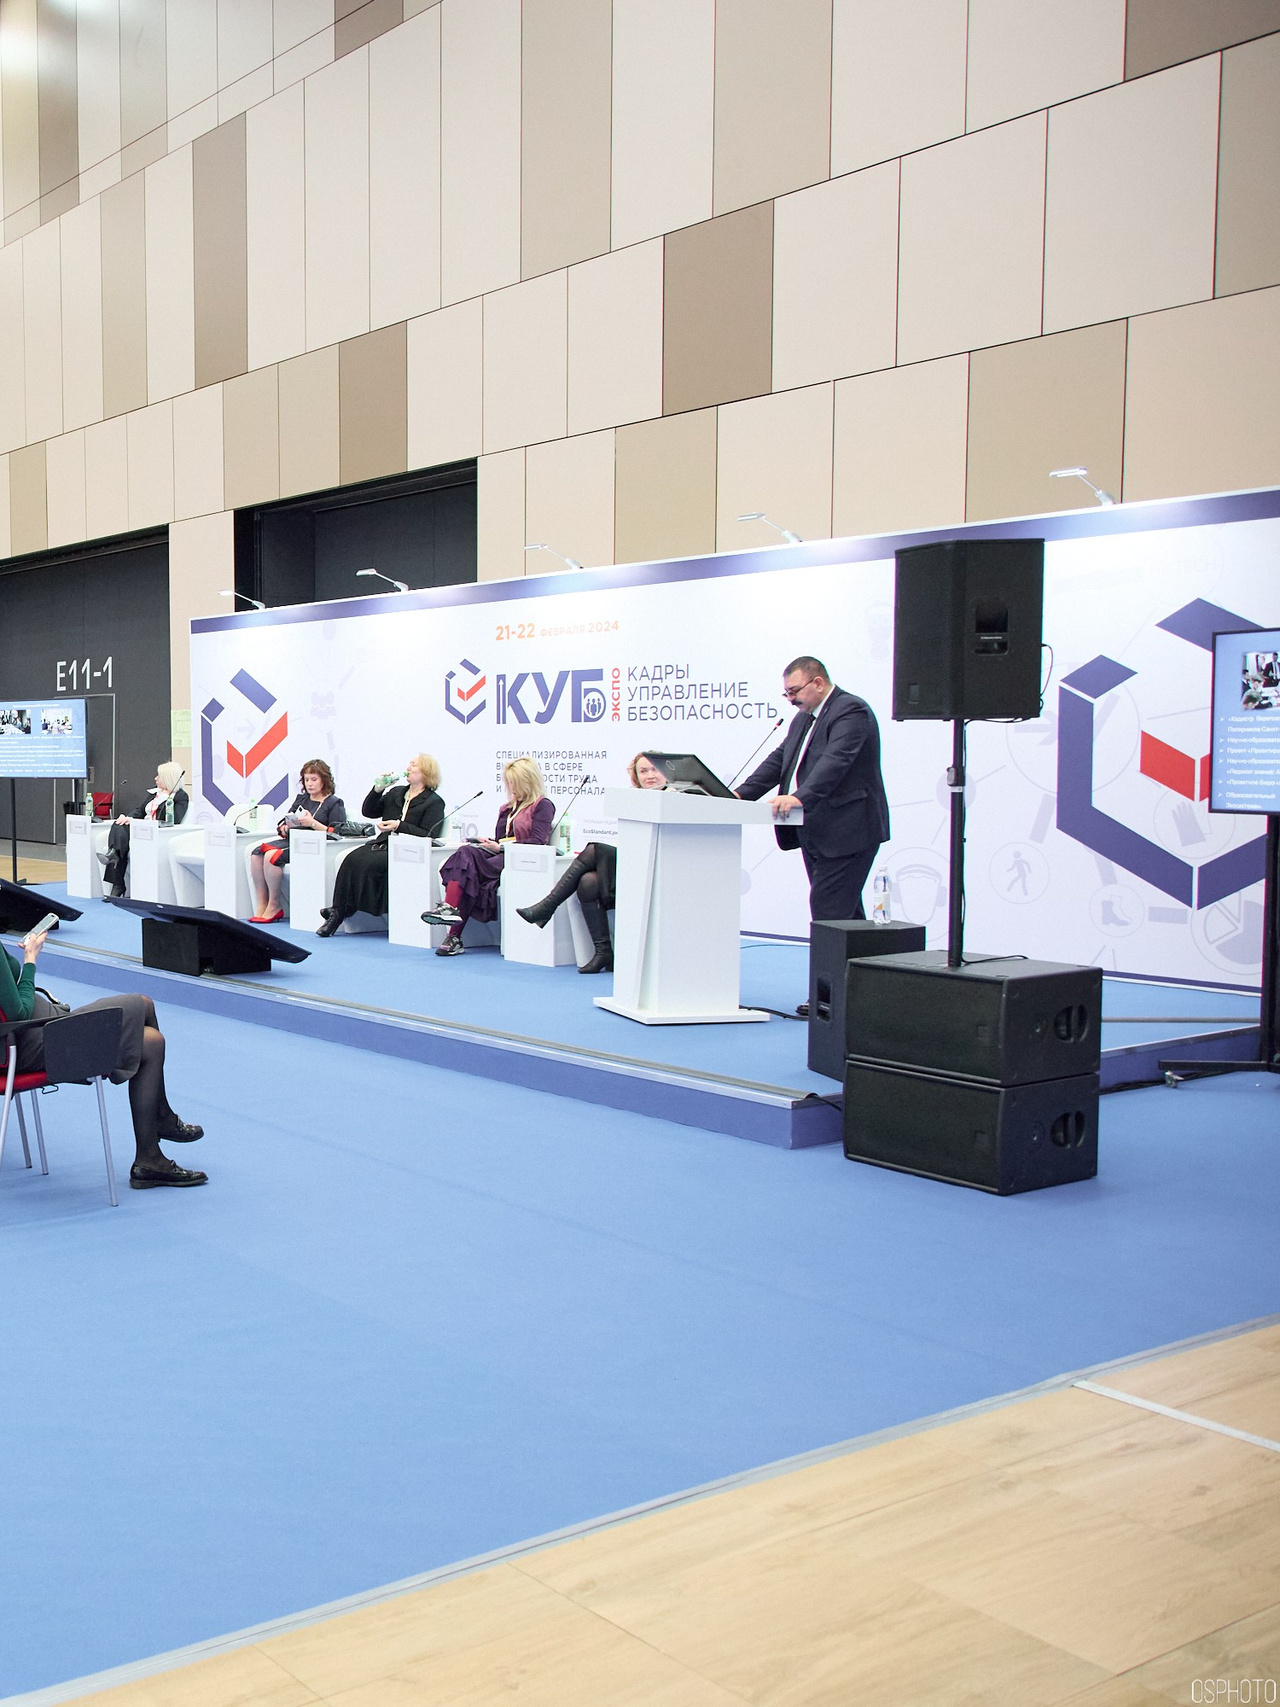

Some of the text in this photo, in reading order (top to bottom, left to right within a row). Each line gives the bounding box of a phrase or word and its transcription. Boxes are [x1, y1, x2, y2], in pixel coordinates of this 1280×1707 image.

[496, 620, 619, 640] 21-22 ФЕВРАЛЯ 2024
[56, 656, 112, 691] E11-1
[627, 664, 689, 683] КАДРЫ
[496, 668, 606, 724] КУБ
[612, 668, 621, 722] ЭКСПО
[627, 682, 748, 701] УПРАВЛЕНИЕ
[627, 702, 778, 721] БЕЗОПАСНОСТЬ
[496, 751, 607, 759] СПЕЦИАЛИЗИРОВАННАЯ
[545, 763, 551, 771] В
[553, 762, 583, 771] СФЕРЕ
[568, 775, 598, 784] ТРУДА
[496, 785, 502, 793] И
[551, 786, 605, 795] ПЕРСОНАЛА
